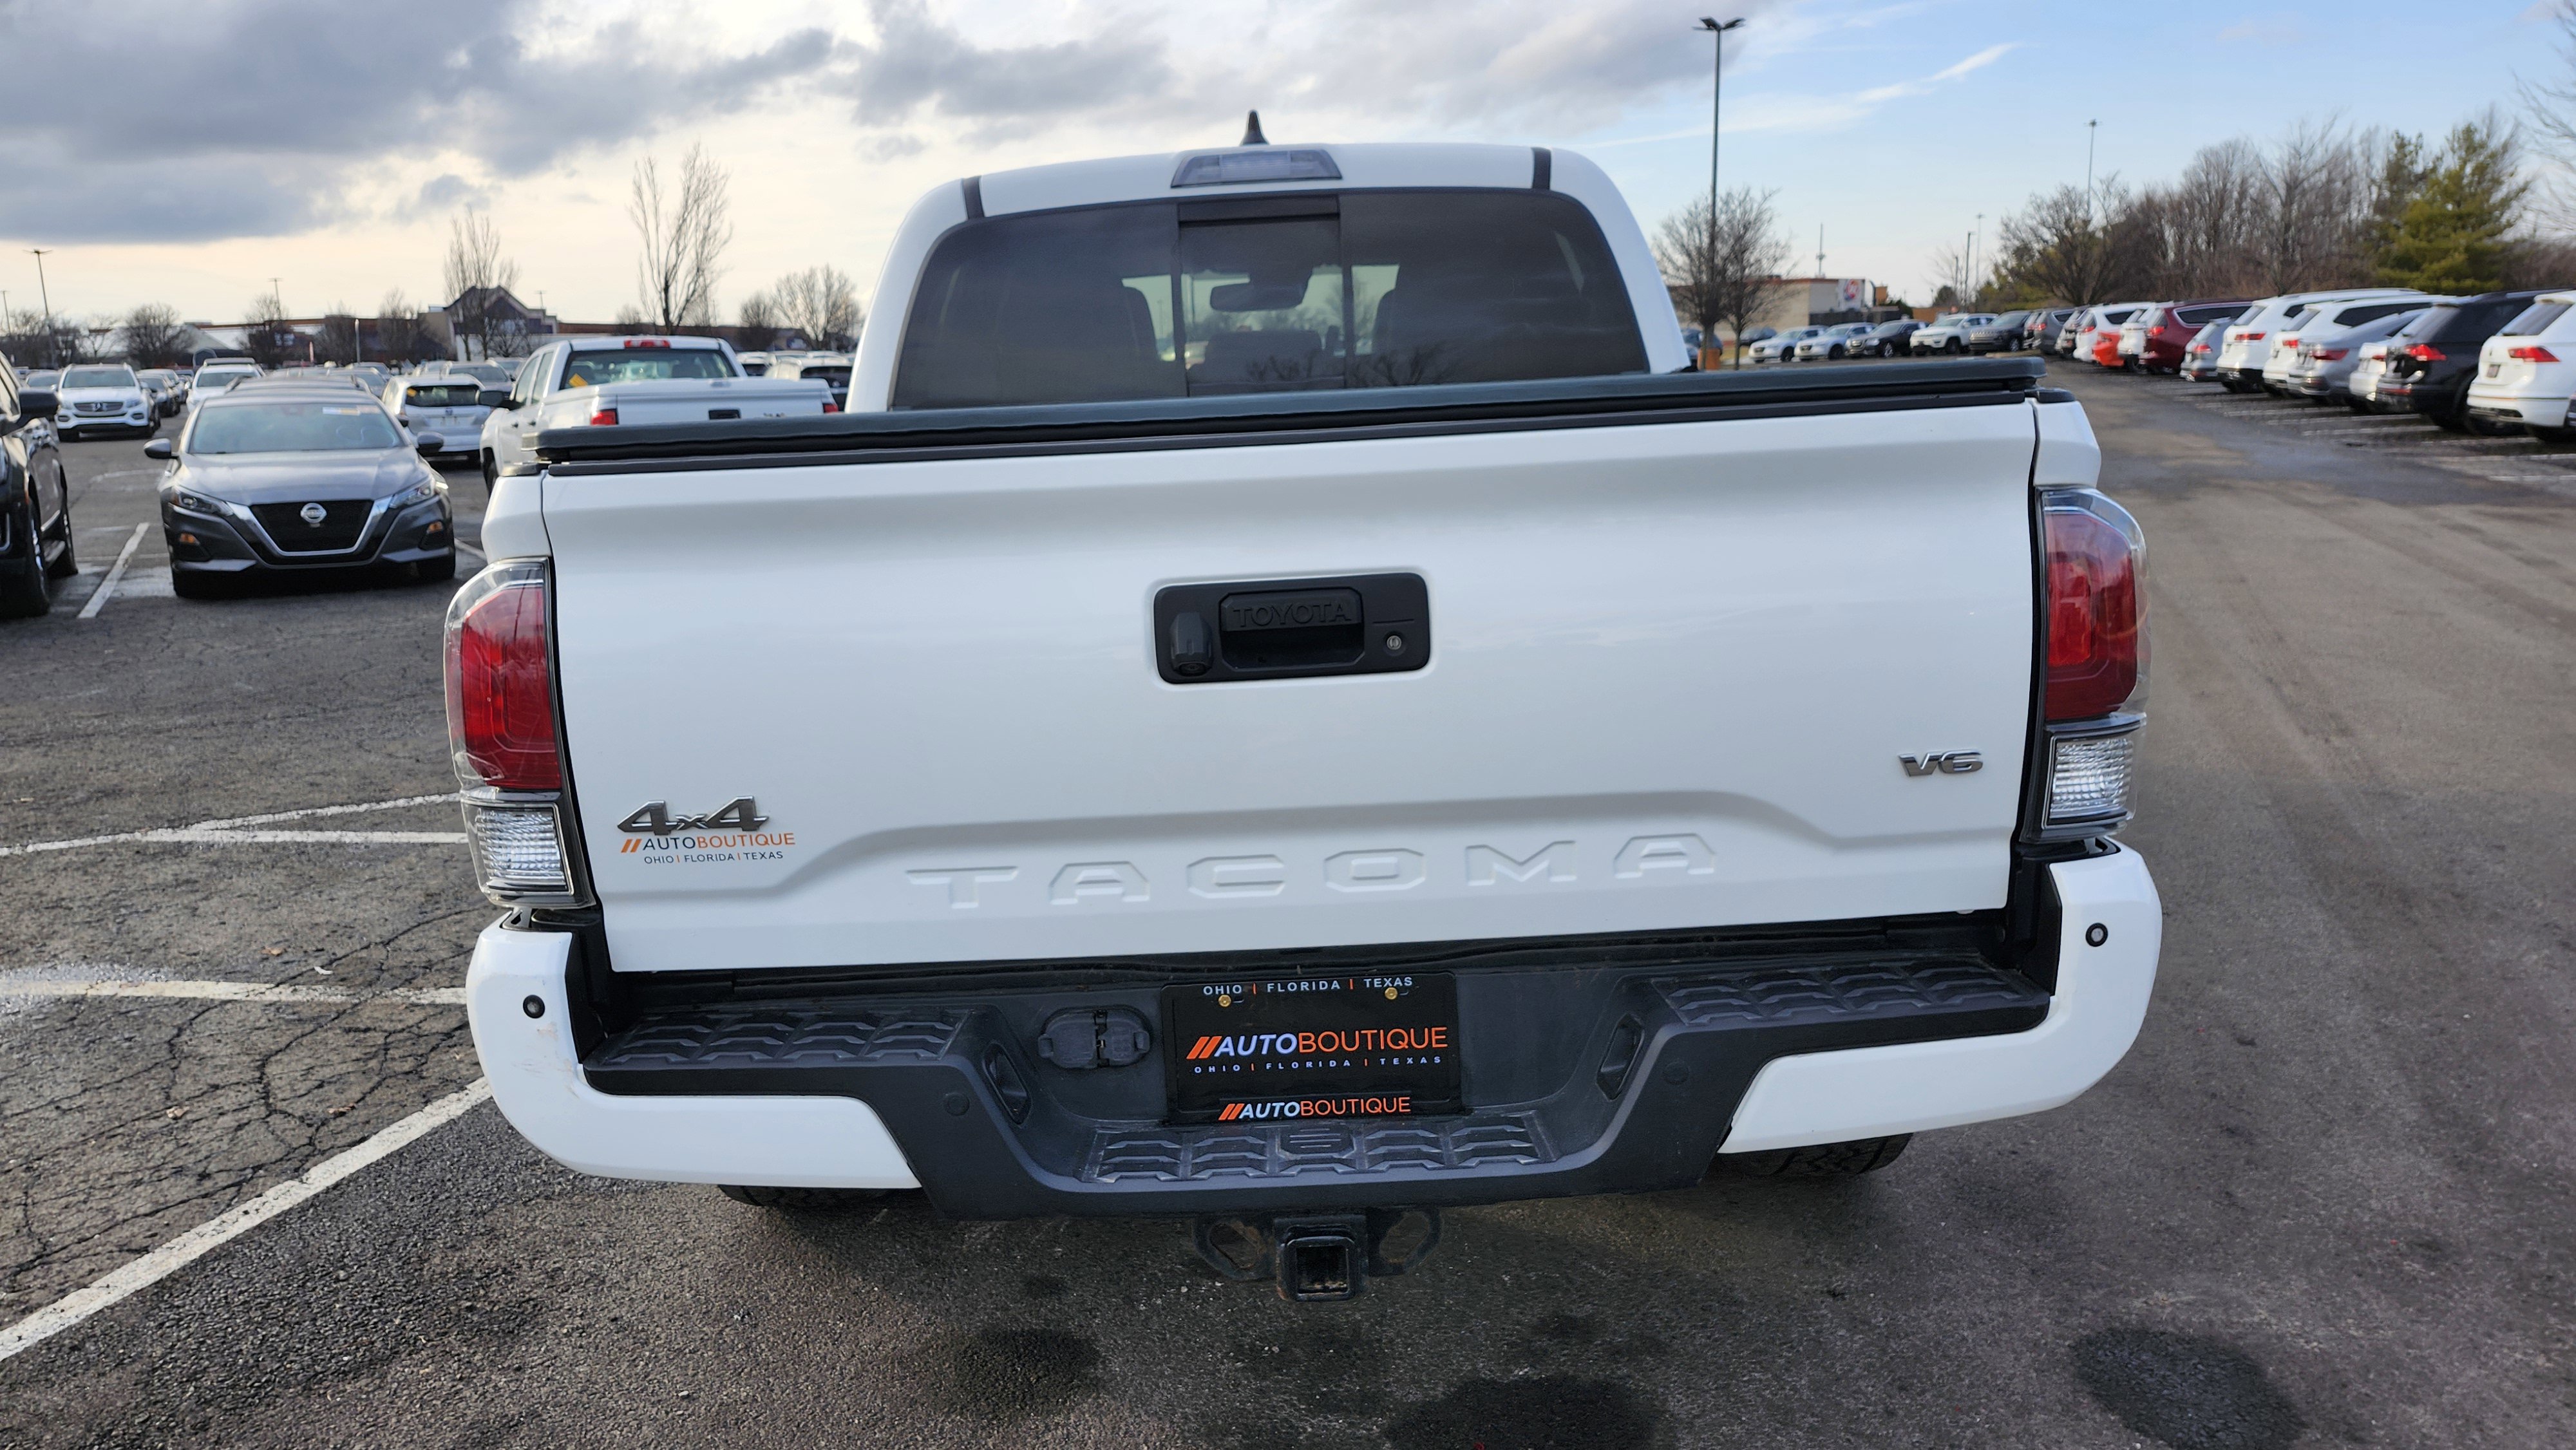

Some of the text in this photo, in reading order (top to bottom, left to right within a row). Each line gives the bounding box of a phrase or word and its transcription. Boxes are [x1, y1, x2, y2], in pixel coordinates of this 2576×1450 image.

[1233, 603, 1352, 627] TOYOTA
[1899, 749, 1984, 777] V6
[617, 795, 770, 835] 4x4
[642, 833, 795, 851] AUTOBOUTIQUE
[644, 851, 783, 864] OHIO FLORIDA TEXAS
[905, 833, 1718, 909] TACOMA
[1203, 977, 1413, 995] OHIO FLORIDA TEXAS
[1215, 1026, 1448, 1057] AUTOBOUTIQUE
[1194, 1056, 1441, 1073] OHIO FLORIDA TEXAS
[1239, 1097, 1412, 1119] AUTOBOUTIQUE
